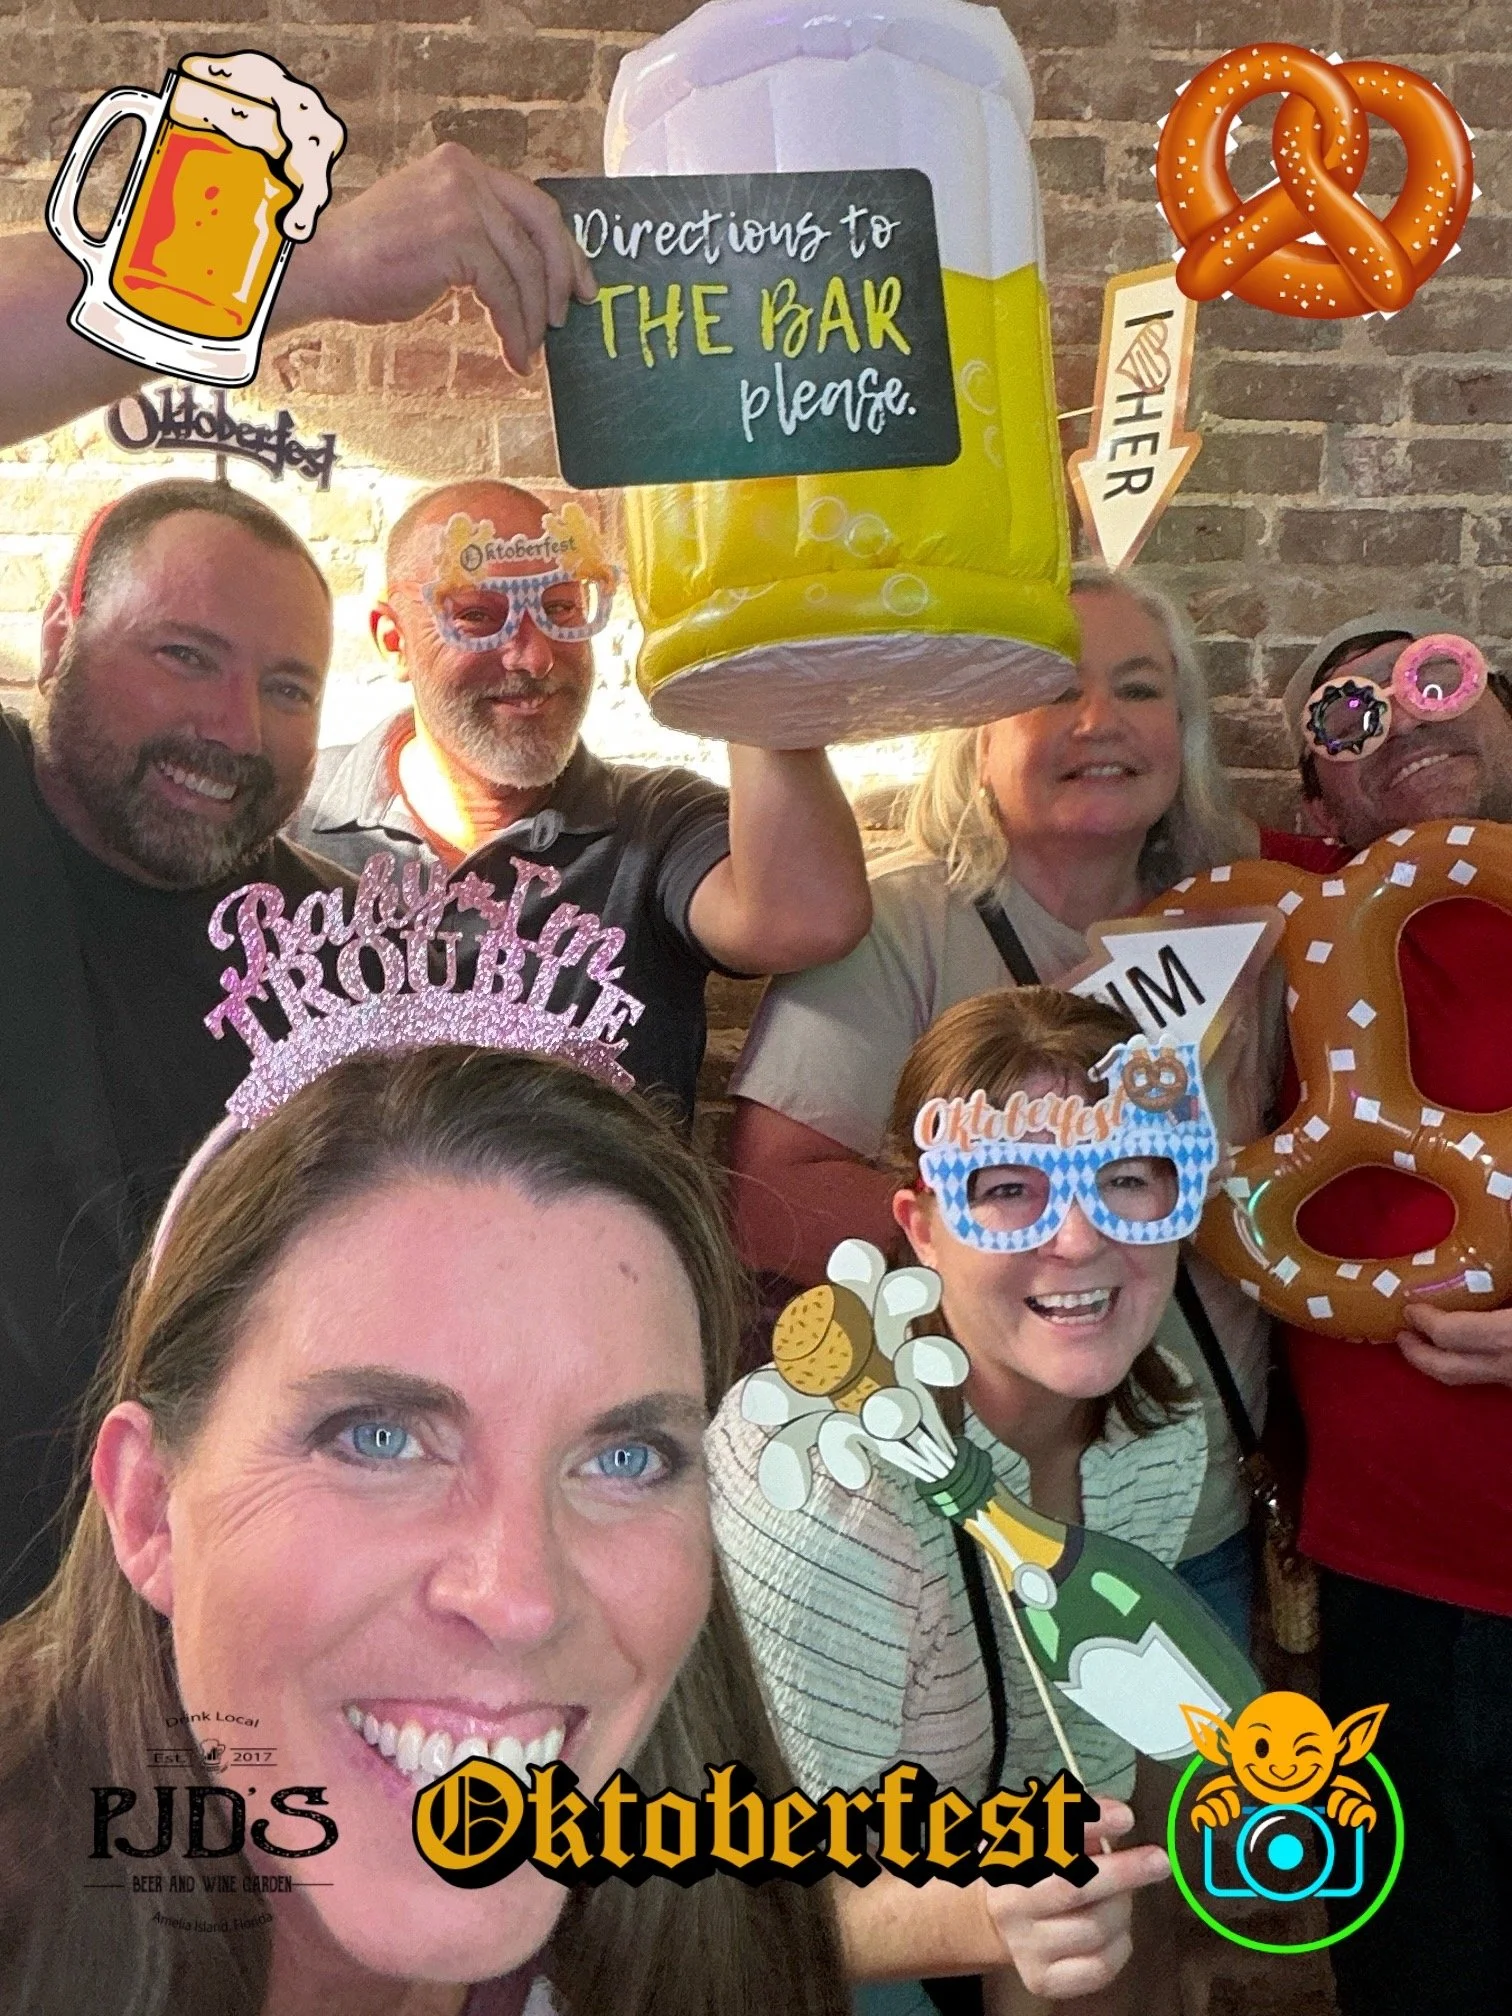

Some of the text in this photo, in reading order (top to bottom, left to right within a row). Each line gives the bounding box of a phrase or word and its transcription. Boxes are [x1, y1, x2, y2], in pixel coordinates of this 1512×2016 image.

[573, 204, 901, 265] Directions to
[594, 276, 912, 369] THE BAR
[107, 386, 338, 493] Oktoberfest
[740, 362, 918, 444] please.
[1103, 387, 1165, 501] HER
[460, 537, 578, 571] Oktoberfest
[203, 929, 648, 1072] TROUBLE
[916, 1084, 1127, 1152] Oktoberfest
